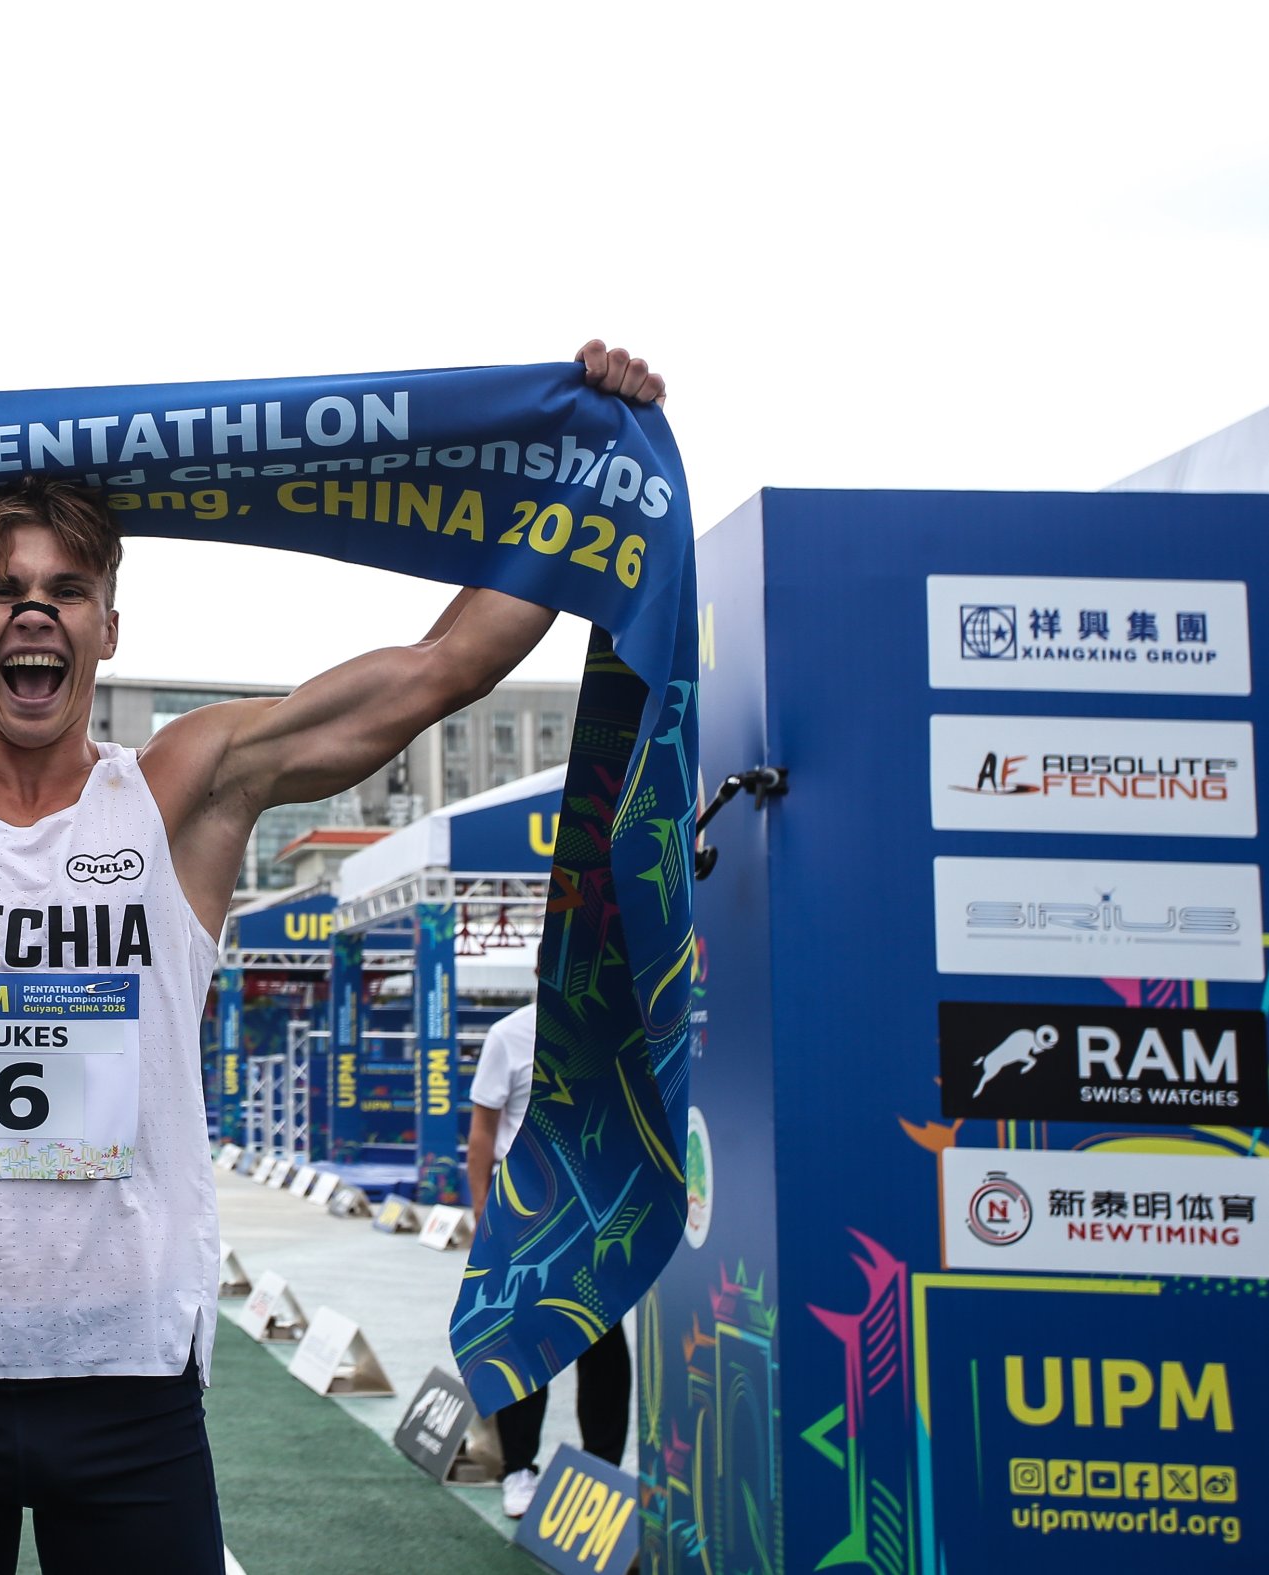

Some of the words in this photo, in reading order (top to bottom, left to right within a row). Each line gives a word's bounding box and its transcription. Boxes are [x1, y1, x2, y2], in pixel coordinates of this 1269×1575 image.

[170, 434, 675, 520] Championships
[277, 480, 485, 542] CHINA
[498, 501, 647, 590] 2026
[1029, 607, 1208, 645] 祥興集團
[1021, 645, 1138, 663] XIANGXING
[1146, 648, 1217, 665] GROUP
[1043, 774, 1228, 801] FENCING
[73, 858, 136, 876] DUKLA
[23, 985, 88, 994] PENTATHLON
[23, 994, 52, 1003] World
[55, 994, 126, 1005] Championships
[23, 1004, 67, 1014] Guiyang,
[69, 1004, 100, 1013] CHINA
[102, 1004, 126, 1012] 2026
[1077, 1025, 1240, 1084] RAM
[338, 1053, 357, 1108] UIPM
[427, 1049, 451, 1116] UIPM
[1080, 1086, 1142, 1105] SWISS
[1147, 1087, 1240, 1107] WATCHES
[1048, 1188, 1256, 1223] 新泰明体育
[1068, 1222, 1241, 1246] NEWTIMING
[1004, 1354, 1235, 1432] UIPM
[538, 1466, 636, 1573] UIPM
[1011, 1503, 1241, 1543] uipmworld.org
